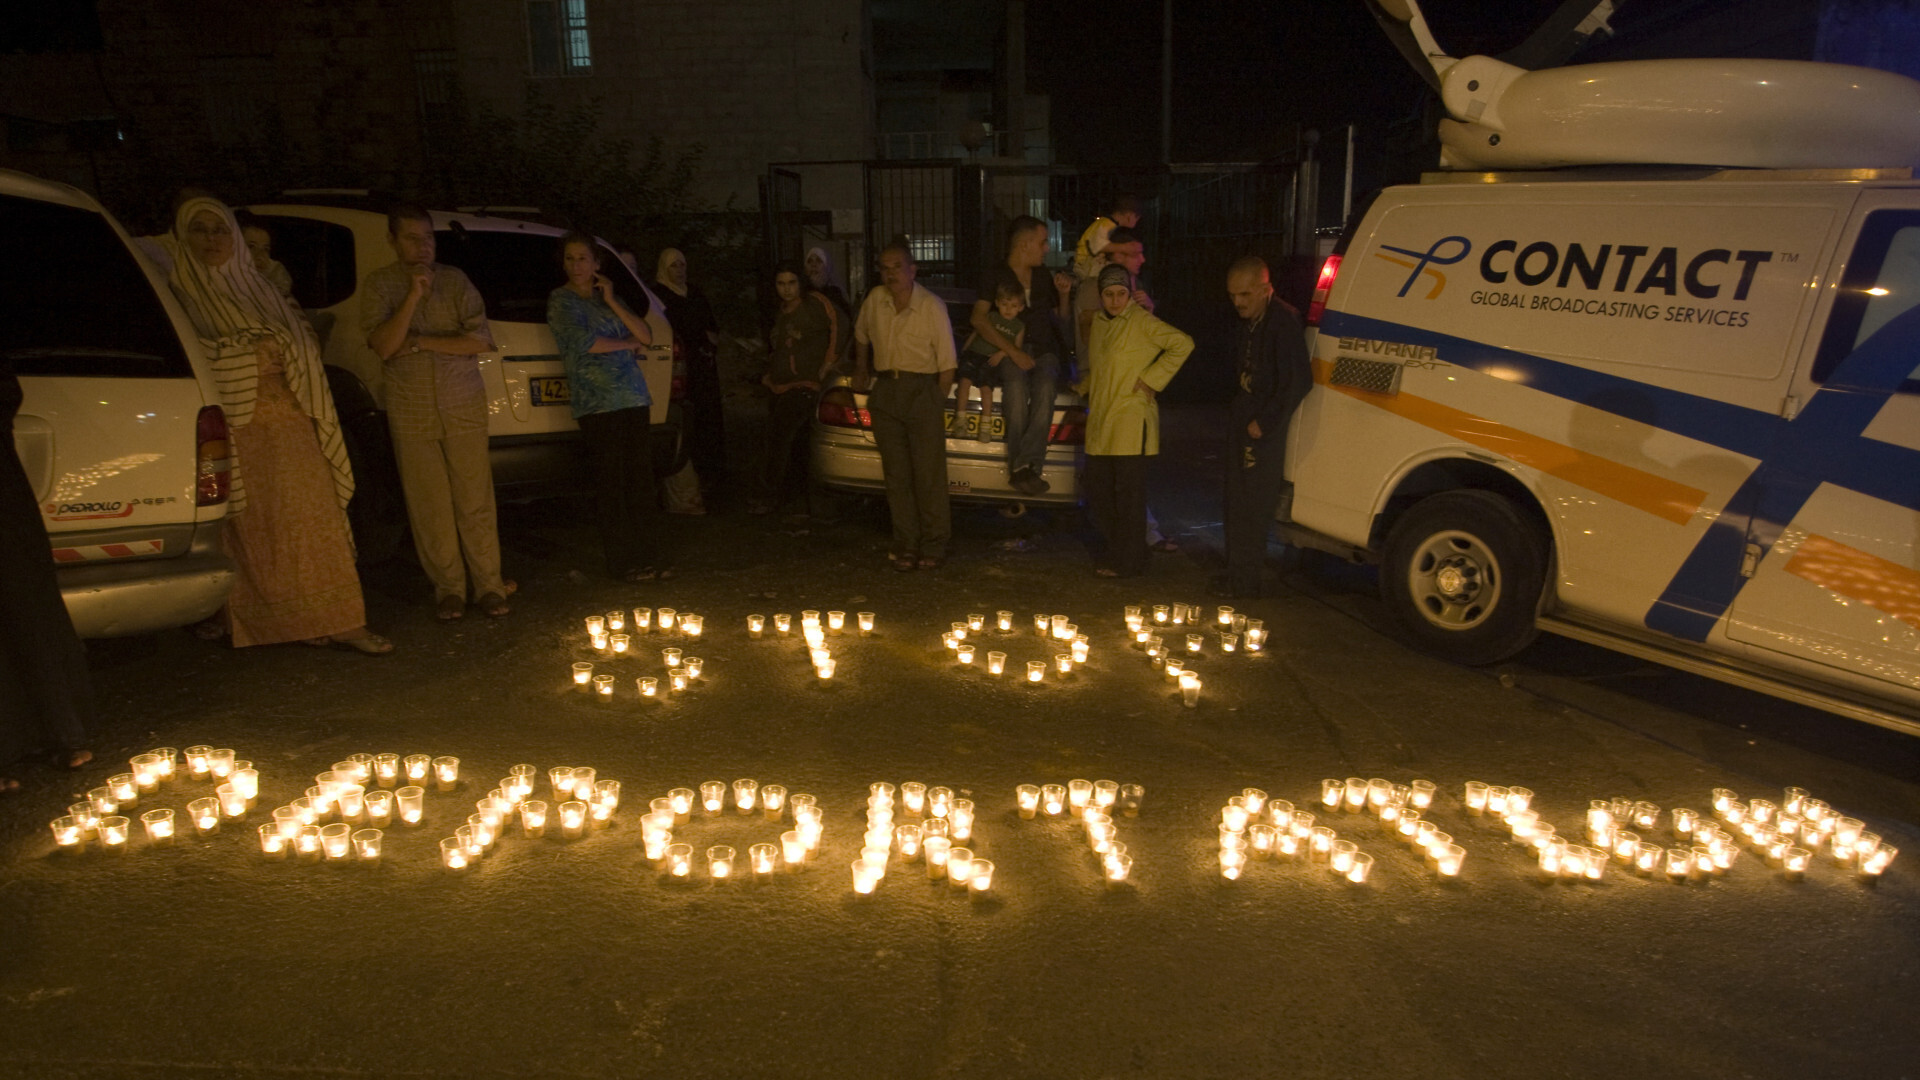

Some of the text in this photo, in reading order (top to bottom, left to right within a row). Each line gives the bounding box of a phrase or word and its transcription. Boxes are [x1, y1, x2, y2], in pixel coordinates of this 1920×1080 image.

[1480, 239, 1773, 301] CONTACT
[1470, 290, 1750, 328] GLOBAL BROADCASTING SERVICES
[1338, 336, 1438, 361] SAVANA
[57, 501, 122, 516] PEDROLLO
[571, 605, 1268, 708] STOP
